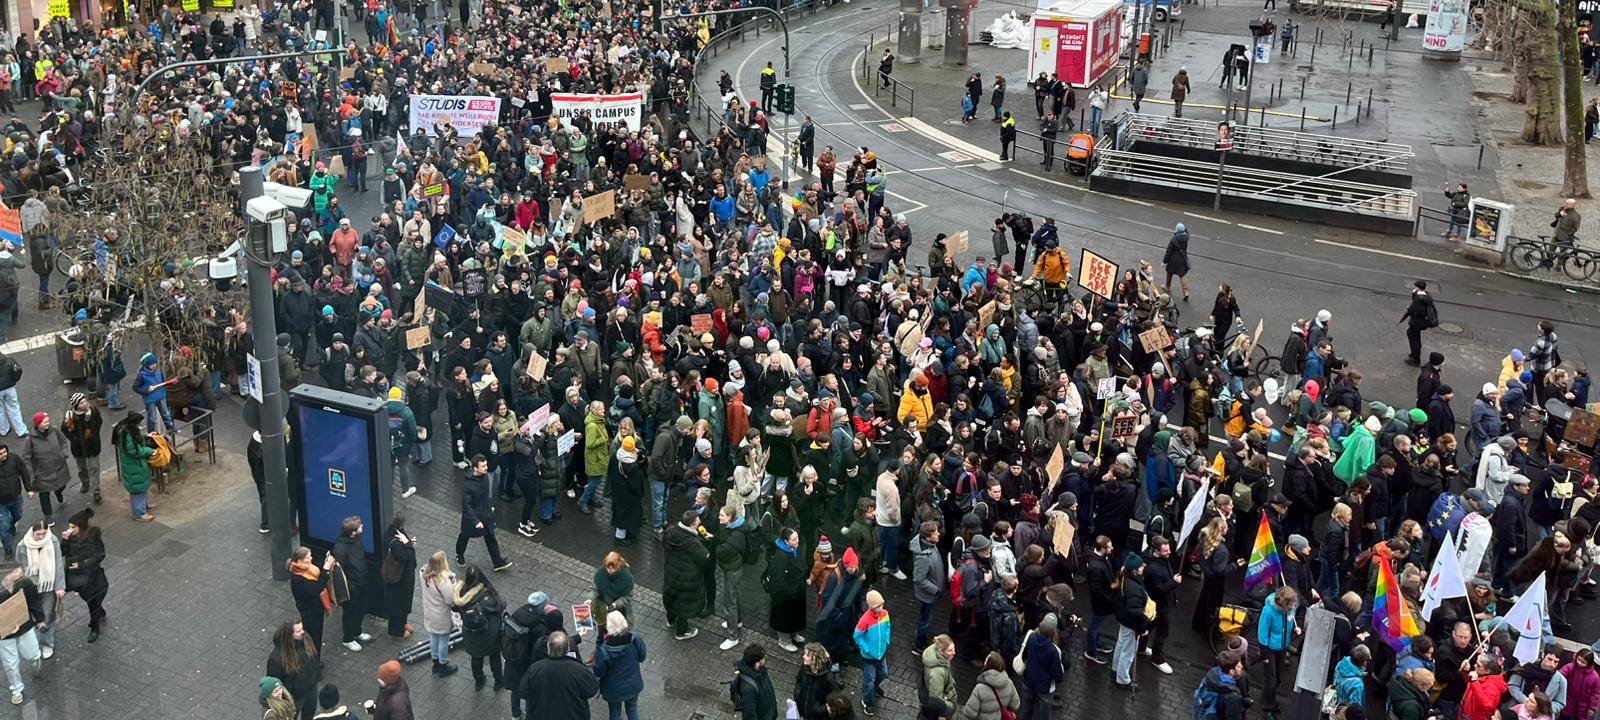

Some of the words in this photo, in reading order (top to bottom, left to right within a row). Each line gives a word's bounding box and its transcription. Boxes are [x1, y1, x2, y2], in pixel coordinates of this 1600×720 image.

[1425, 37, 1447, 48] MIND
[418, 99, 466, 110] STUDIS
[595, 107, 636, 118] CAMPUS
[1114, 419, 1134, 428] FCK
[1112, 427, 1133, 436] AFD
